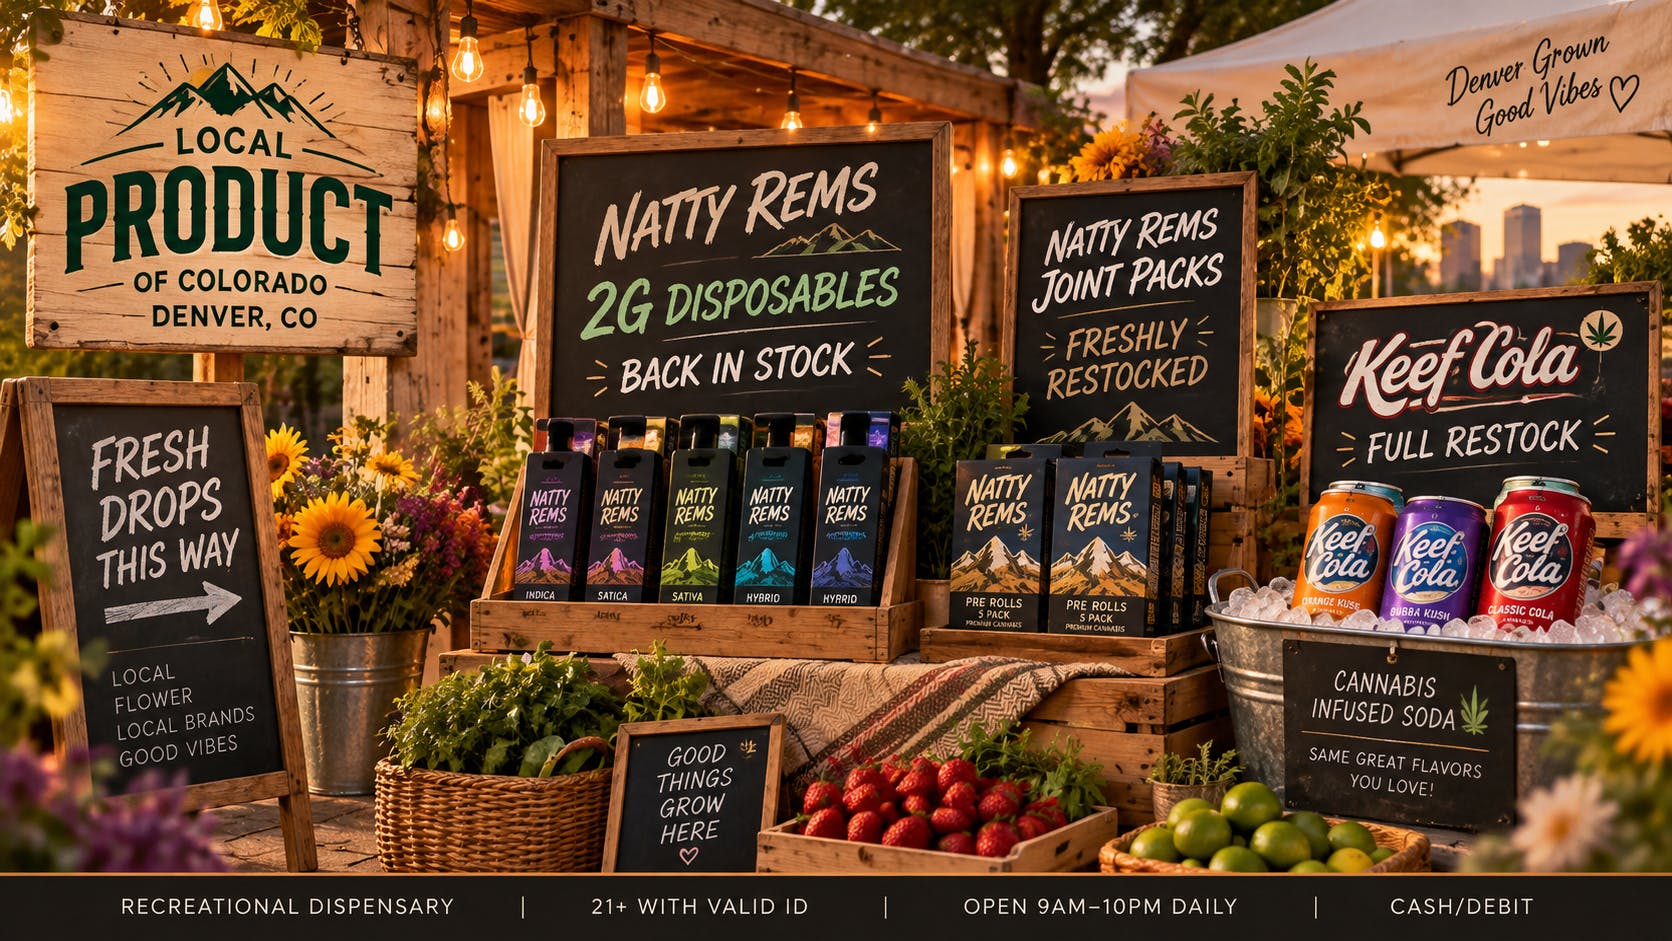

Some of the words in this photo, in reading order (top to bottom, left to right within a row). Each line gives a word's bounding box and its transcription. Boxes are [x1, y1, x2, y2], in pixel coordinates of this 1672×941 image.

[1445, 61, 1524, 106] Denver
[1533, 35, 1610, 81] Grown
[1475, 86, 1535, 137] Good
[1540, 72, 1603, 115] Vibes
[176, 126, 292, 159] LOCAL
[65, 165, 393, 276] PRODUCT
[594, 184, 737, 267] NATTY
[744, 161, 879, 235] REMS
[1044, 217, 1132, 267] NATTY
[1136, 207, 1219, 250] REMS
[133, 270, 168, 293] OF
[178, 269, 327, 296] COLORADO
[1031, 263, 1125, 314] JOINT
[1128, 252, 1225, 296] PACKS
[152, 305, 271, 331] DENVER,
[281, 306, 317, 329] CO
[579, 277, 654, 341] 2G
[665, 266, 901, 326] DISPOSABLES
[1065, 317, 1189, 362] FRESHLY
[620, 353, 703, 394] BACK
[712, 349, 744, 385] IN
[754, 341, 855, 382] STOCK
[1046, 355, 1209, 401] RESTOCKED
[1337, 328, 1476, 419] Keef
[1468, 321, 1582, 392] Cola
[1367, 429, 1434, 464] FULL
[1445, 419, 1583, 458] RESTOCK
[91, 425, 209, 491] FRESH
[530, 489, 571, 508] NATTY
[601, 488, 643, 507] NATTY
[675, 487, 718, 506] NATTY
[750, 486, 793, 506] NATTY
[825, 486, 871, 506] NATTY
[964, 474, 1032, 506] NATTY
[1065, 472, 1137, 506] NATTY
[100, 477, 221, 543] DROPS
[529, 507, 567, 526] REMS
[600, 506, 639, 525] REMS
[674, 505, 714, 525] REMS
[749, 505, 790, 525] REMS
[825, 505, 868, 524] REMS
[966, 501, 1028, 531] REMS
[1067, 501, 1132, 532] REMS
[1306, 522, 1376, 558] Keef
[1394, 529, 1465, 566] Keef
[1492, 521, 1569, 561] Keef
[96, 541, 167, 589] THIS
[179, 527, 240, 574] WAY
[1307, 552, 1370, 584] Cola
[1496, 554, 1562, 588] Cola
[1396, 559, 1459, 594] Cola
[526, 591, 555, 600] INDICA
[598, 592, 628, 601] SATICA
[672, 592, 703, 602] SATIVA
[746, 593, 780, 603] HYBRID
[966, 597, 986, 607] PRE
[990, 598, 1023, 609] ROLLS
[1066, 600, 1087, 611] PRE
[1092, 601, 1127, 612] ROLLS
[987, 609, 1010, 620] PACK
[1089, 613, 1113, 623] PACK
[1488, 605, 1526, 616] CLASSIC
[1529, 608, 1554, 621] COLA
[112, 664, 176, 687] LOCAL
[1334, 670, 1437, 698] CANNABIS
[115, 687, 193, 714] FLOWER
[1311, 698, 1394, 725] INFUSED
[1402, 705, 1456, 731] SODA
[117, 716, 178, 741] LOCAL
[185, 706, 256, 732] BRANDS
[119, 743, 178, 768] GOOD
[187, 734, 238, 757] VIBES
[667, 743, 726, 768] GOOD
[1309, 747, 1350, 765] SAME
[1356, 752, 1406, 770] GREAT
[1412, 758, 1482, 779] FLAVORS
[657, 767, 734, 793] THINGS
[1350, 774, 1382, 790] YOU
[1388, 779, 1434, 797] LOVE!
[660, 793, 726, 819] GROW
[660, 819, 720, 845] HERE
